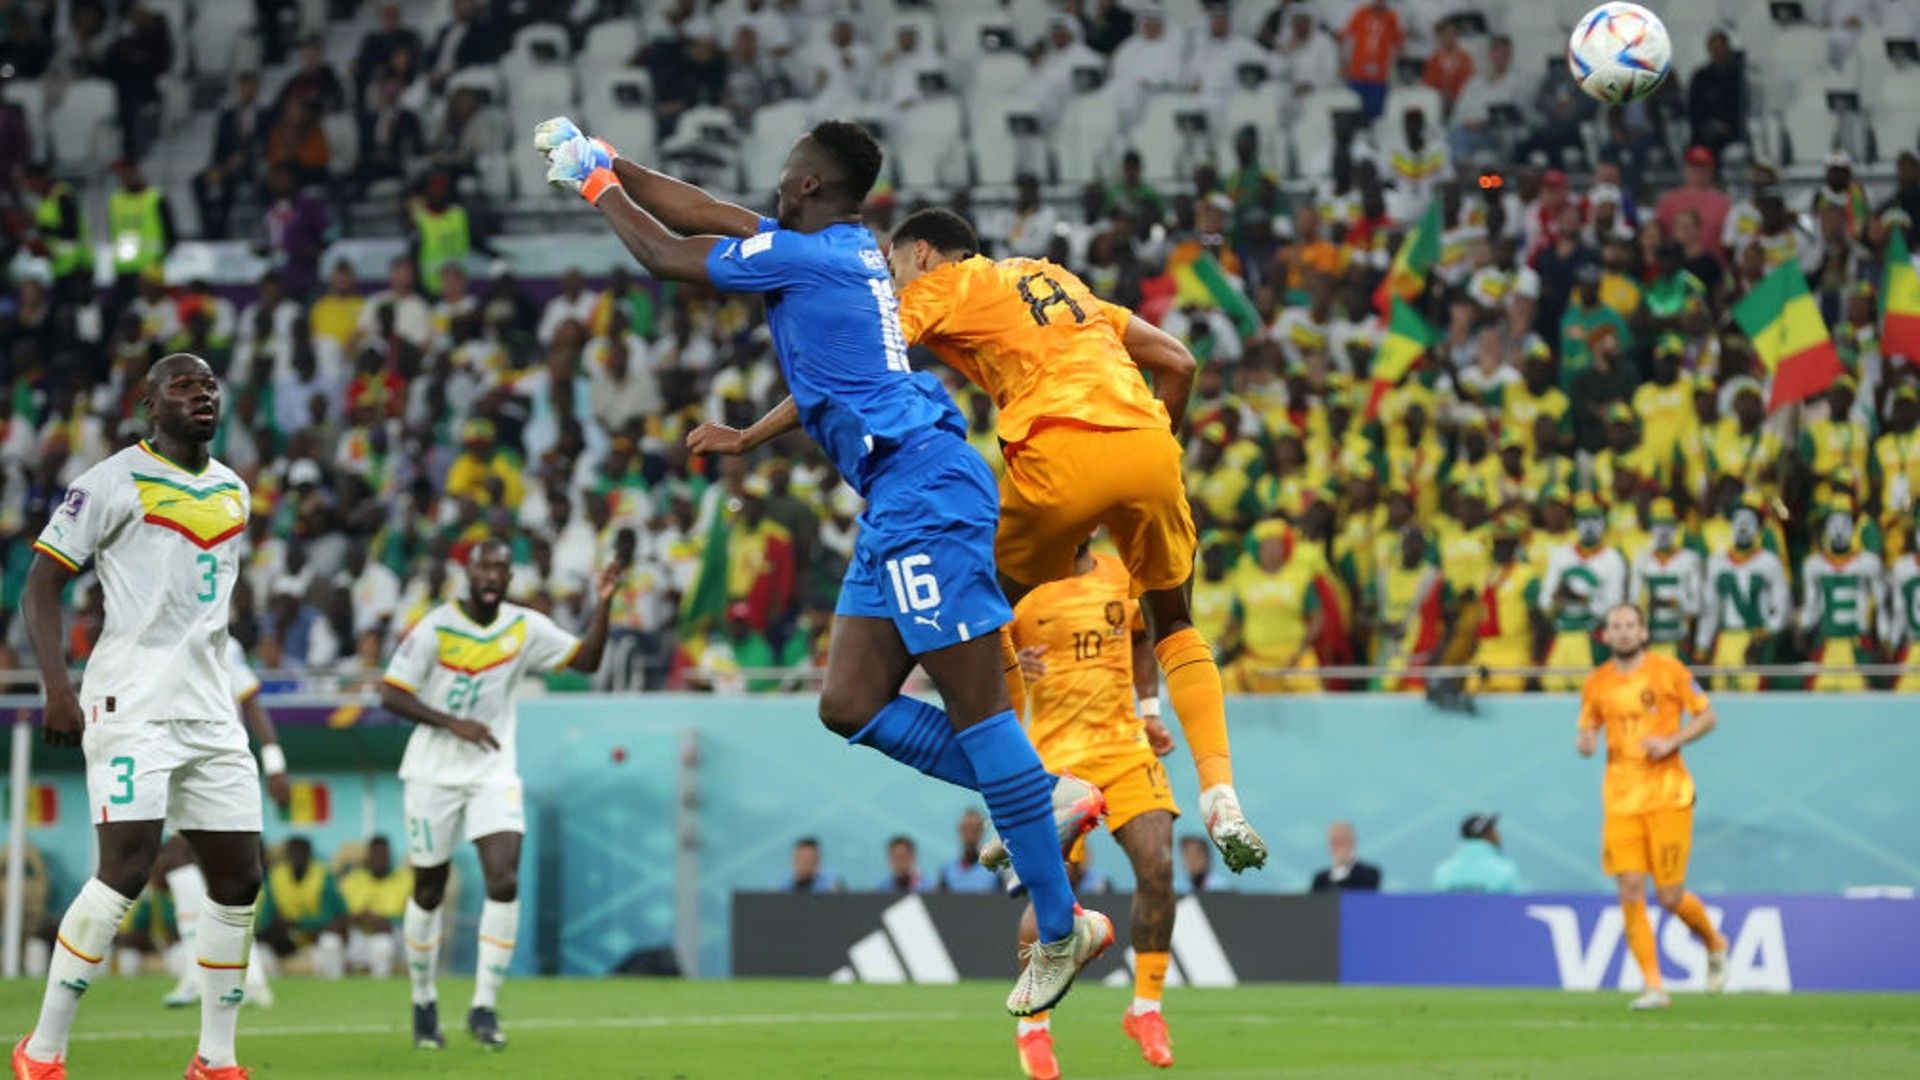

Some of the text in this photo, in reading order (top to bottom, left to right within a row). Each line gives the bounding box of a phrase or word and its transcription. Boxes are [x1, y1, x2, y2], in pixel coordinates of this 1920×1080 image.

[196, 553, 217, 603] 3
[886, 553, 941, 614] 16
[1072, 629, 1103, 662] 10
[447, 673, 482, 711] 21
[110, 756, 135, 804] 3
[409, 817, 433, 853] 21
[1524, 904, 1792, 993] VISA
